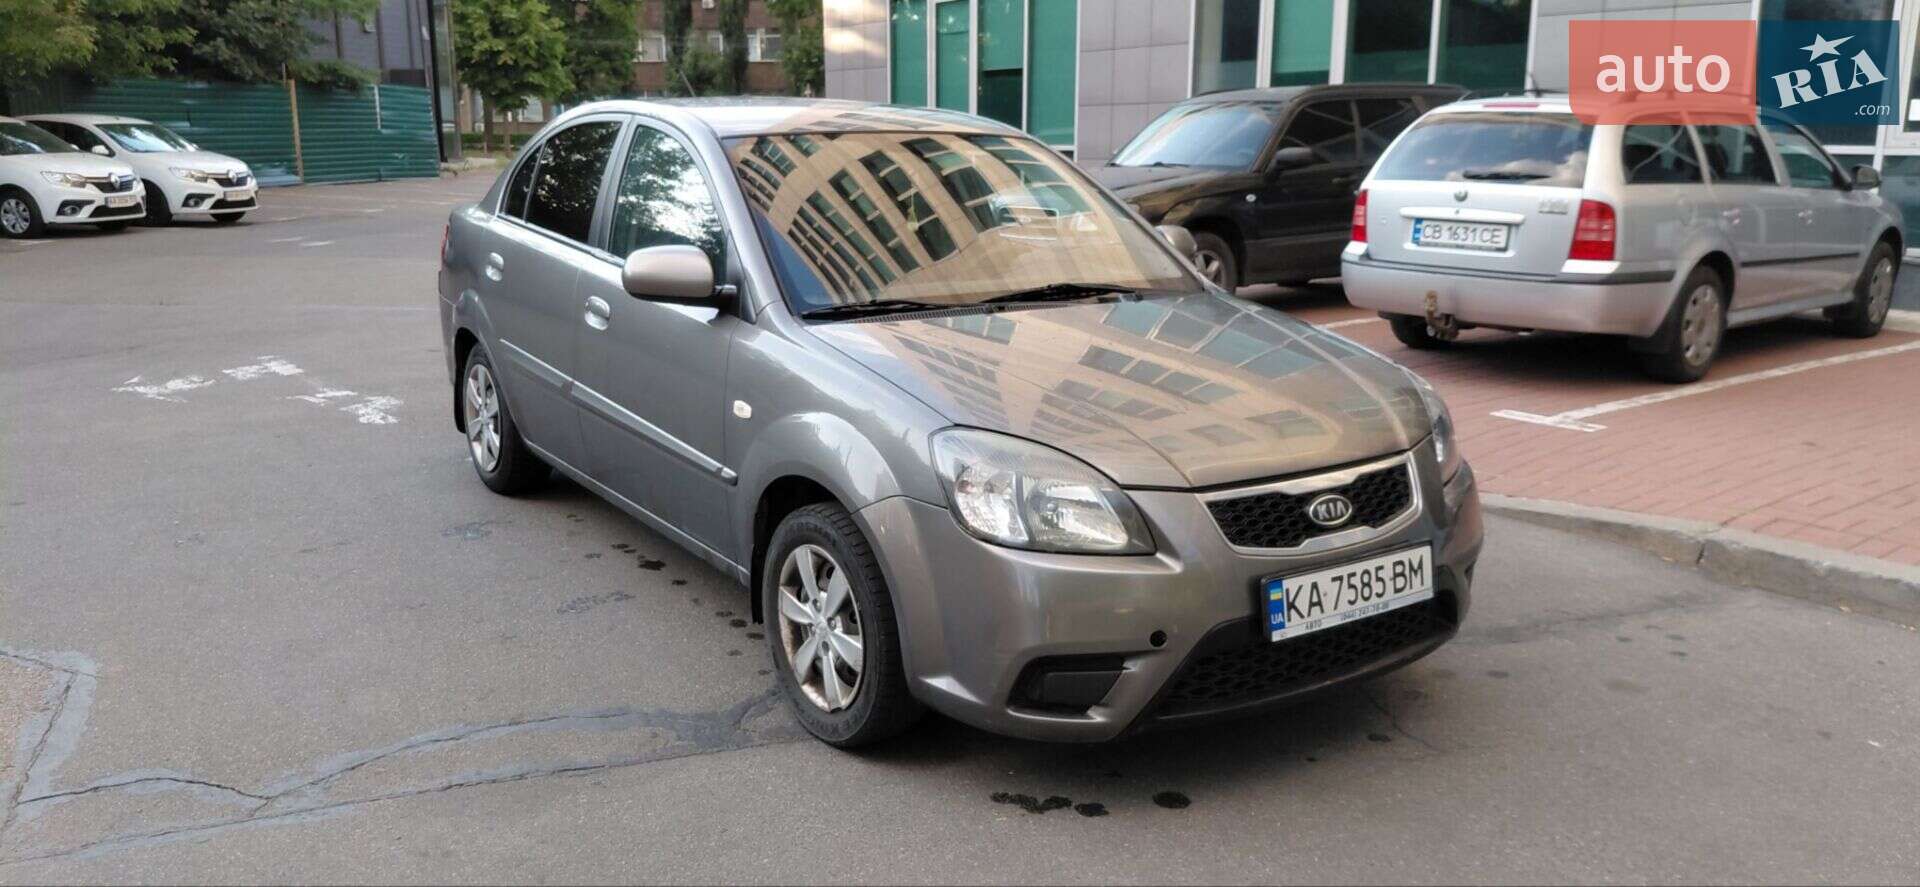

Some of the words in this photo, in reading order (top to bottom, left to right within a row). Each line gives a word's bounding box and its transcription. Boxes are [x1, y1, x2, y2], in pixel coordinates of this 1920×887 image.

[1423, 224, 1442, 240] CB
[1447, 225, 1477, 242] 1631
[1481, 228, 1502, 244] CE
[1316, 500, 1347, 520] KIA
[1285, 581, 1325, 622] KA
[1331, 565, 1386, 611] 7585
[1391, 554, 1424, 595] BM
[1271, 613, 1284, 625] UA
